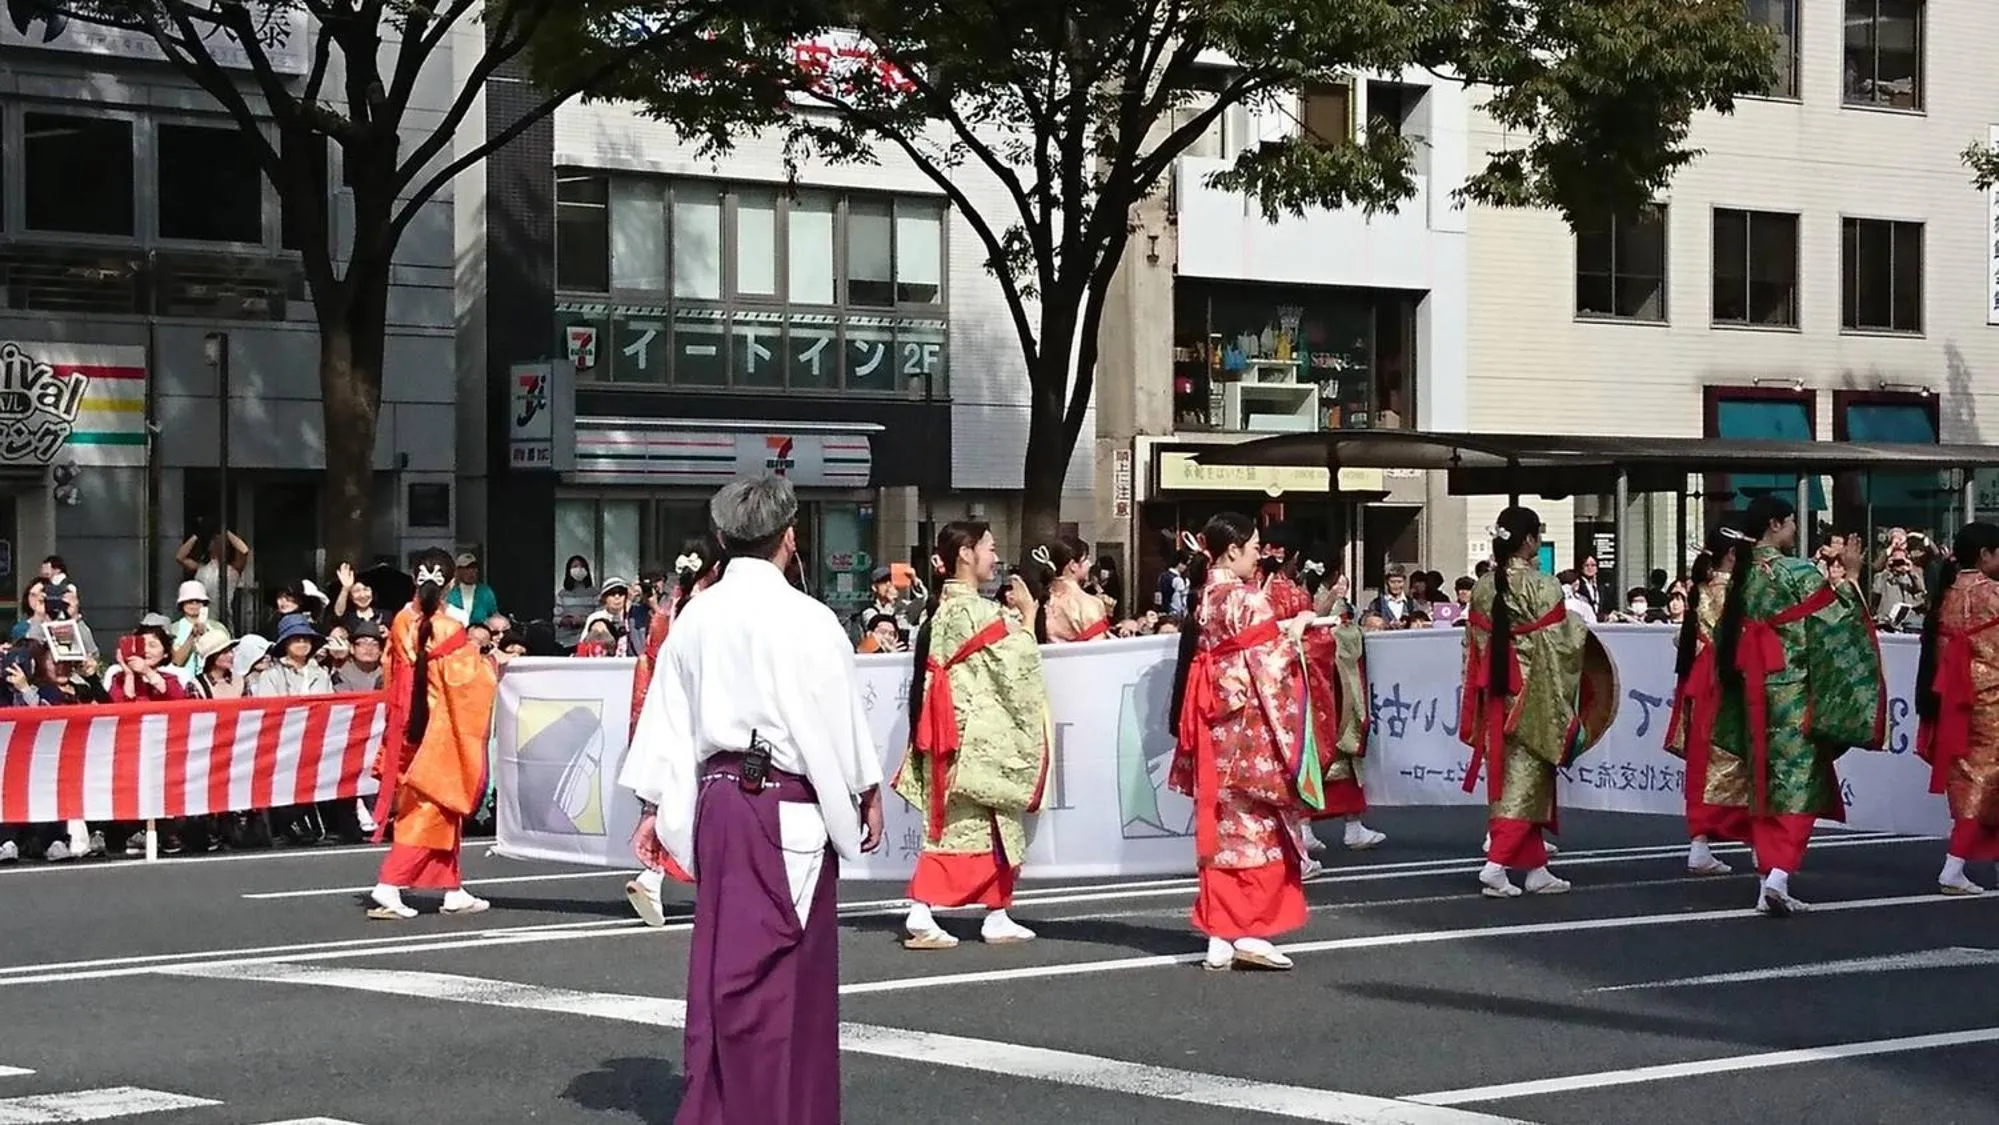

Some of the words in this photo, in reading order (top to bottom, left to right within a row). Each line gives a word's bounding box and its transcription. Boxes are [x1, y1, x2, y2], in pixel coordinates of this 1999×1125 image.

[623, 329, 884, 376] イートイン
[904, 343, 939, 374] 2F
